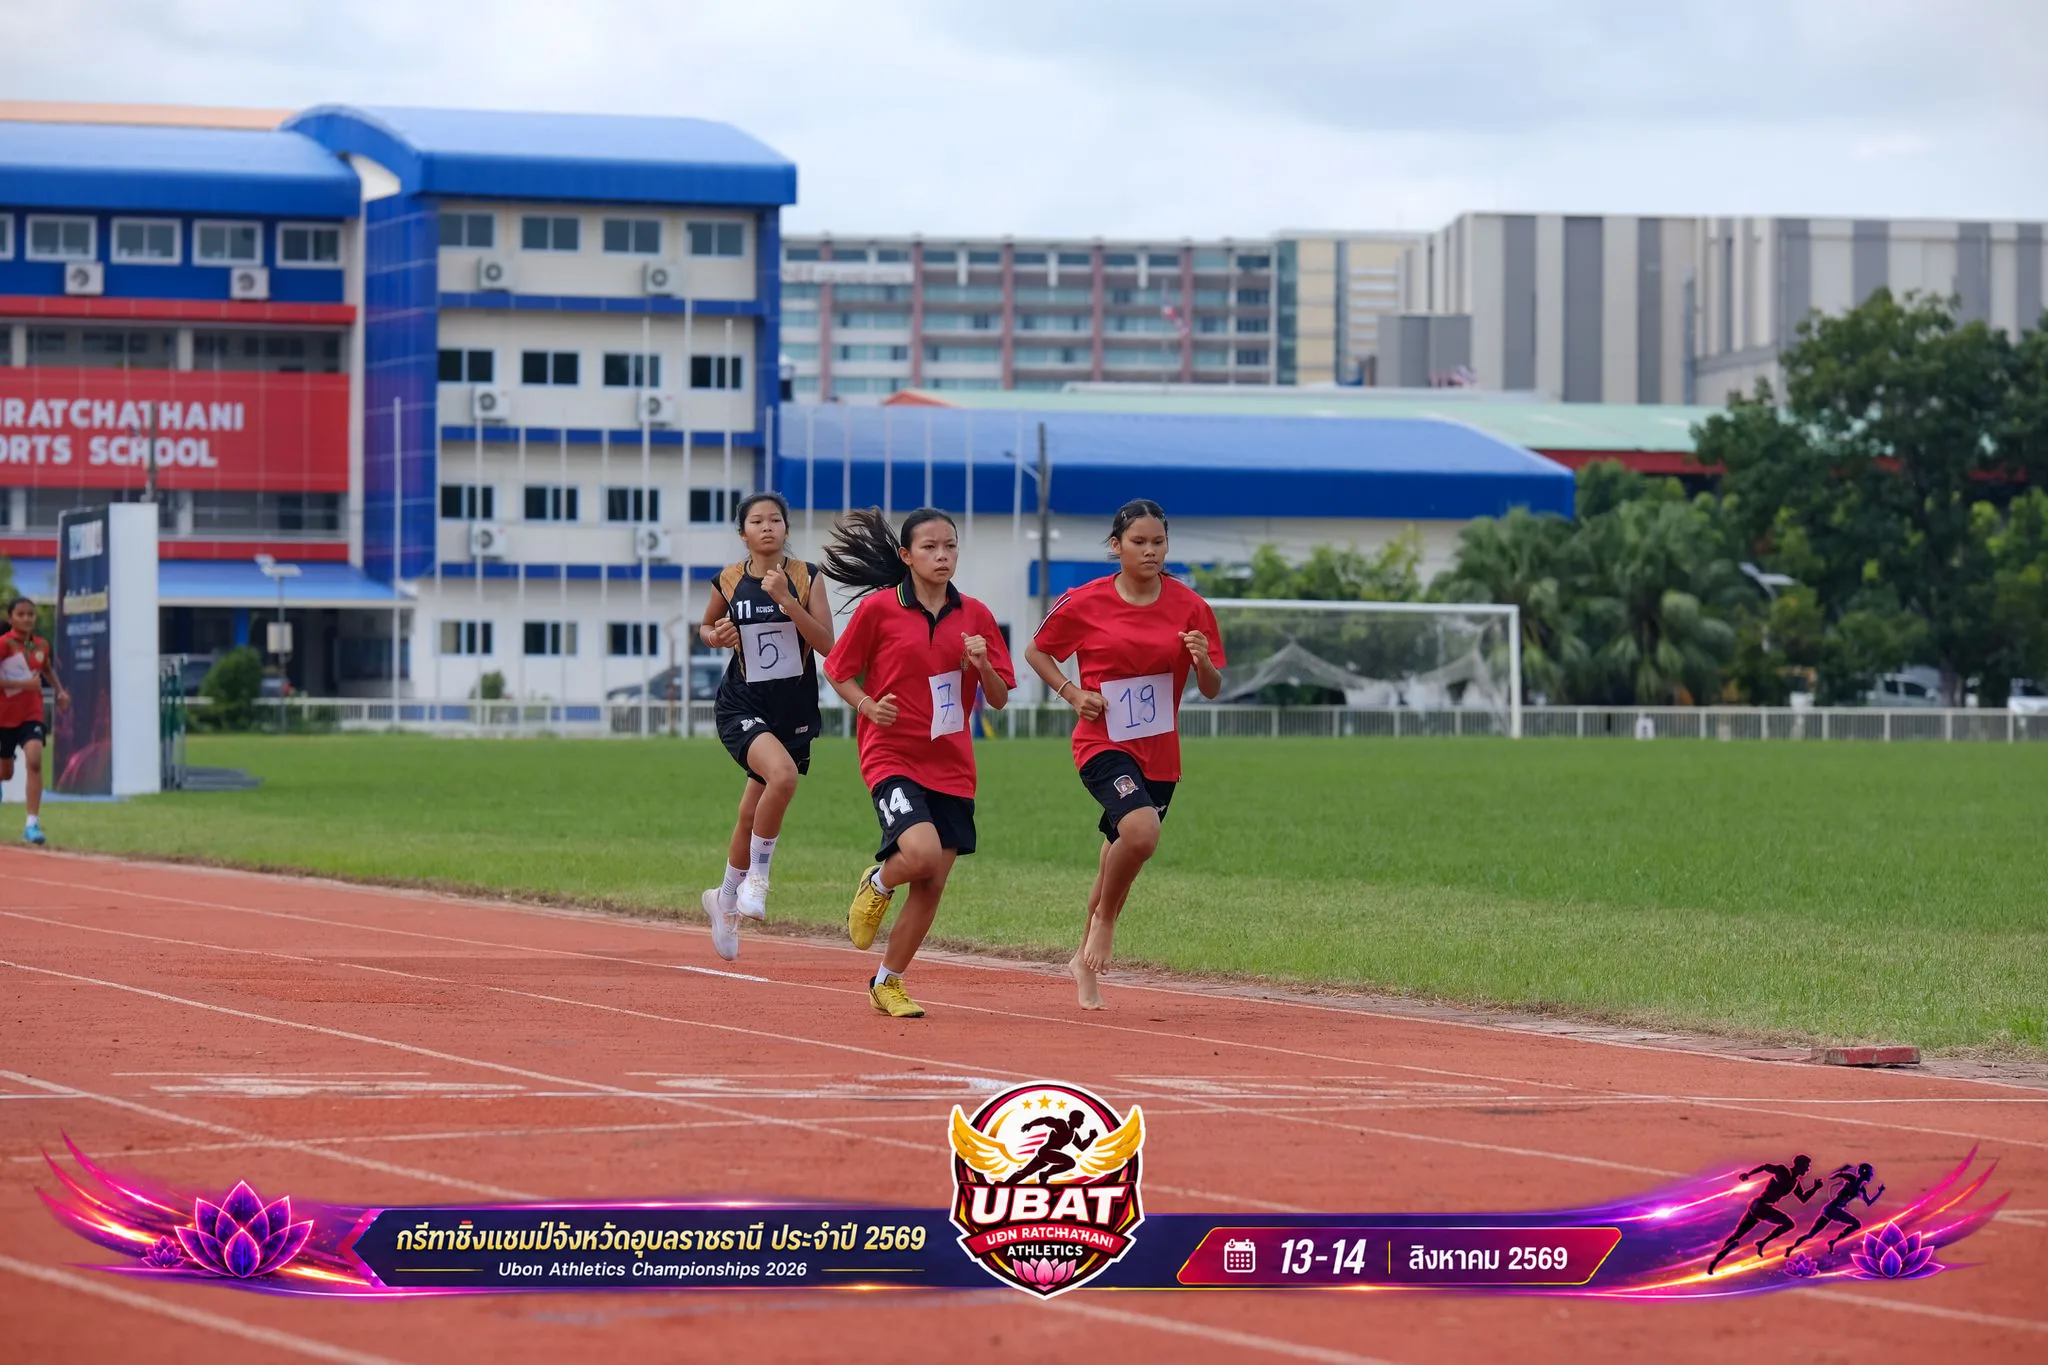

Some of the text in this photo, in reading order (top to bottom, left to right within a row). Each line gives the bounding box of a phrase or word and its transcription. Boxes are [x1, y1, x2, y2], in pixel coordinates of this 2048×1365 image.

[0, 398, 244, 431] RATCHATHANI
[89, 436, 218, 467] SCHOOL
[736, 600, 752, 619] 11
[757, 630, 783, 670] 5
[937, 683, 955, 725] 7
[1120, 684, 1156, 729] 19
[879, 787, 913, 826] 14
